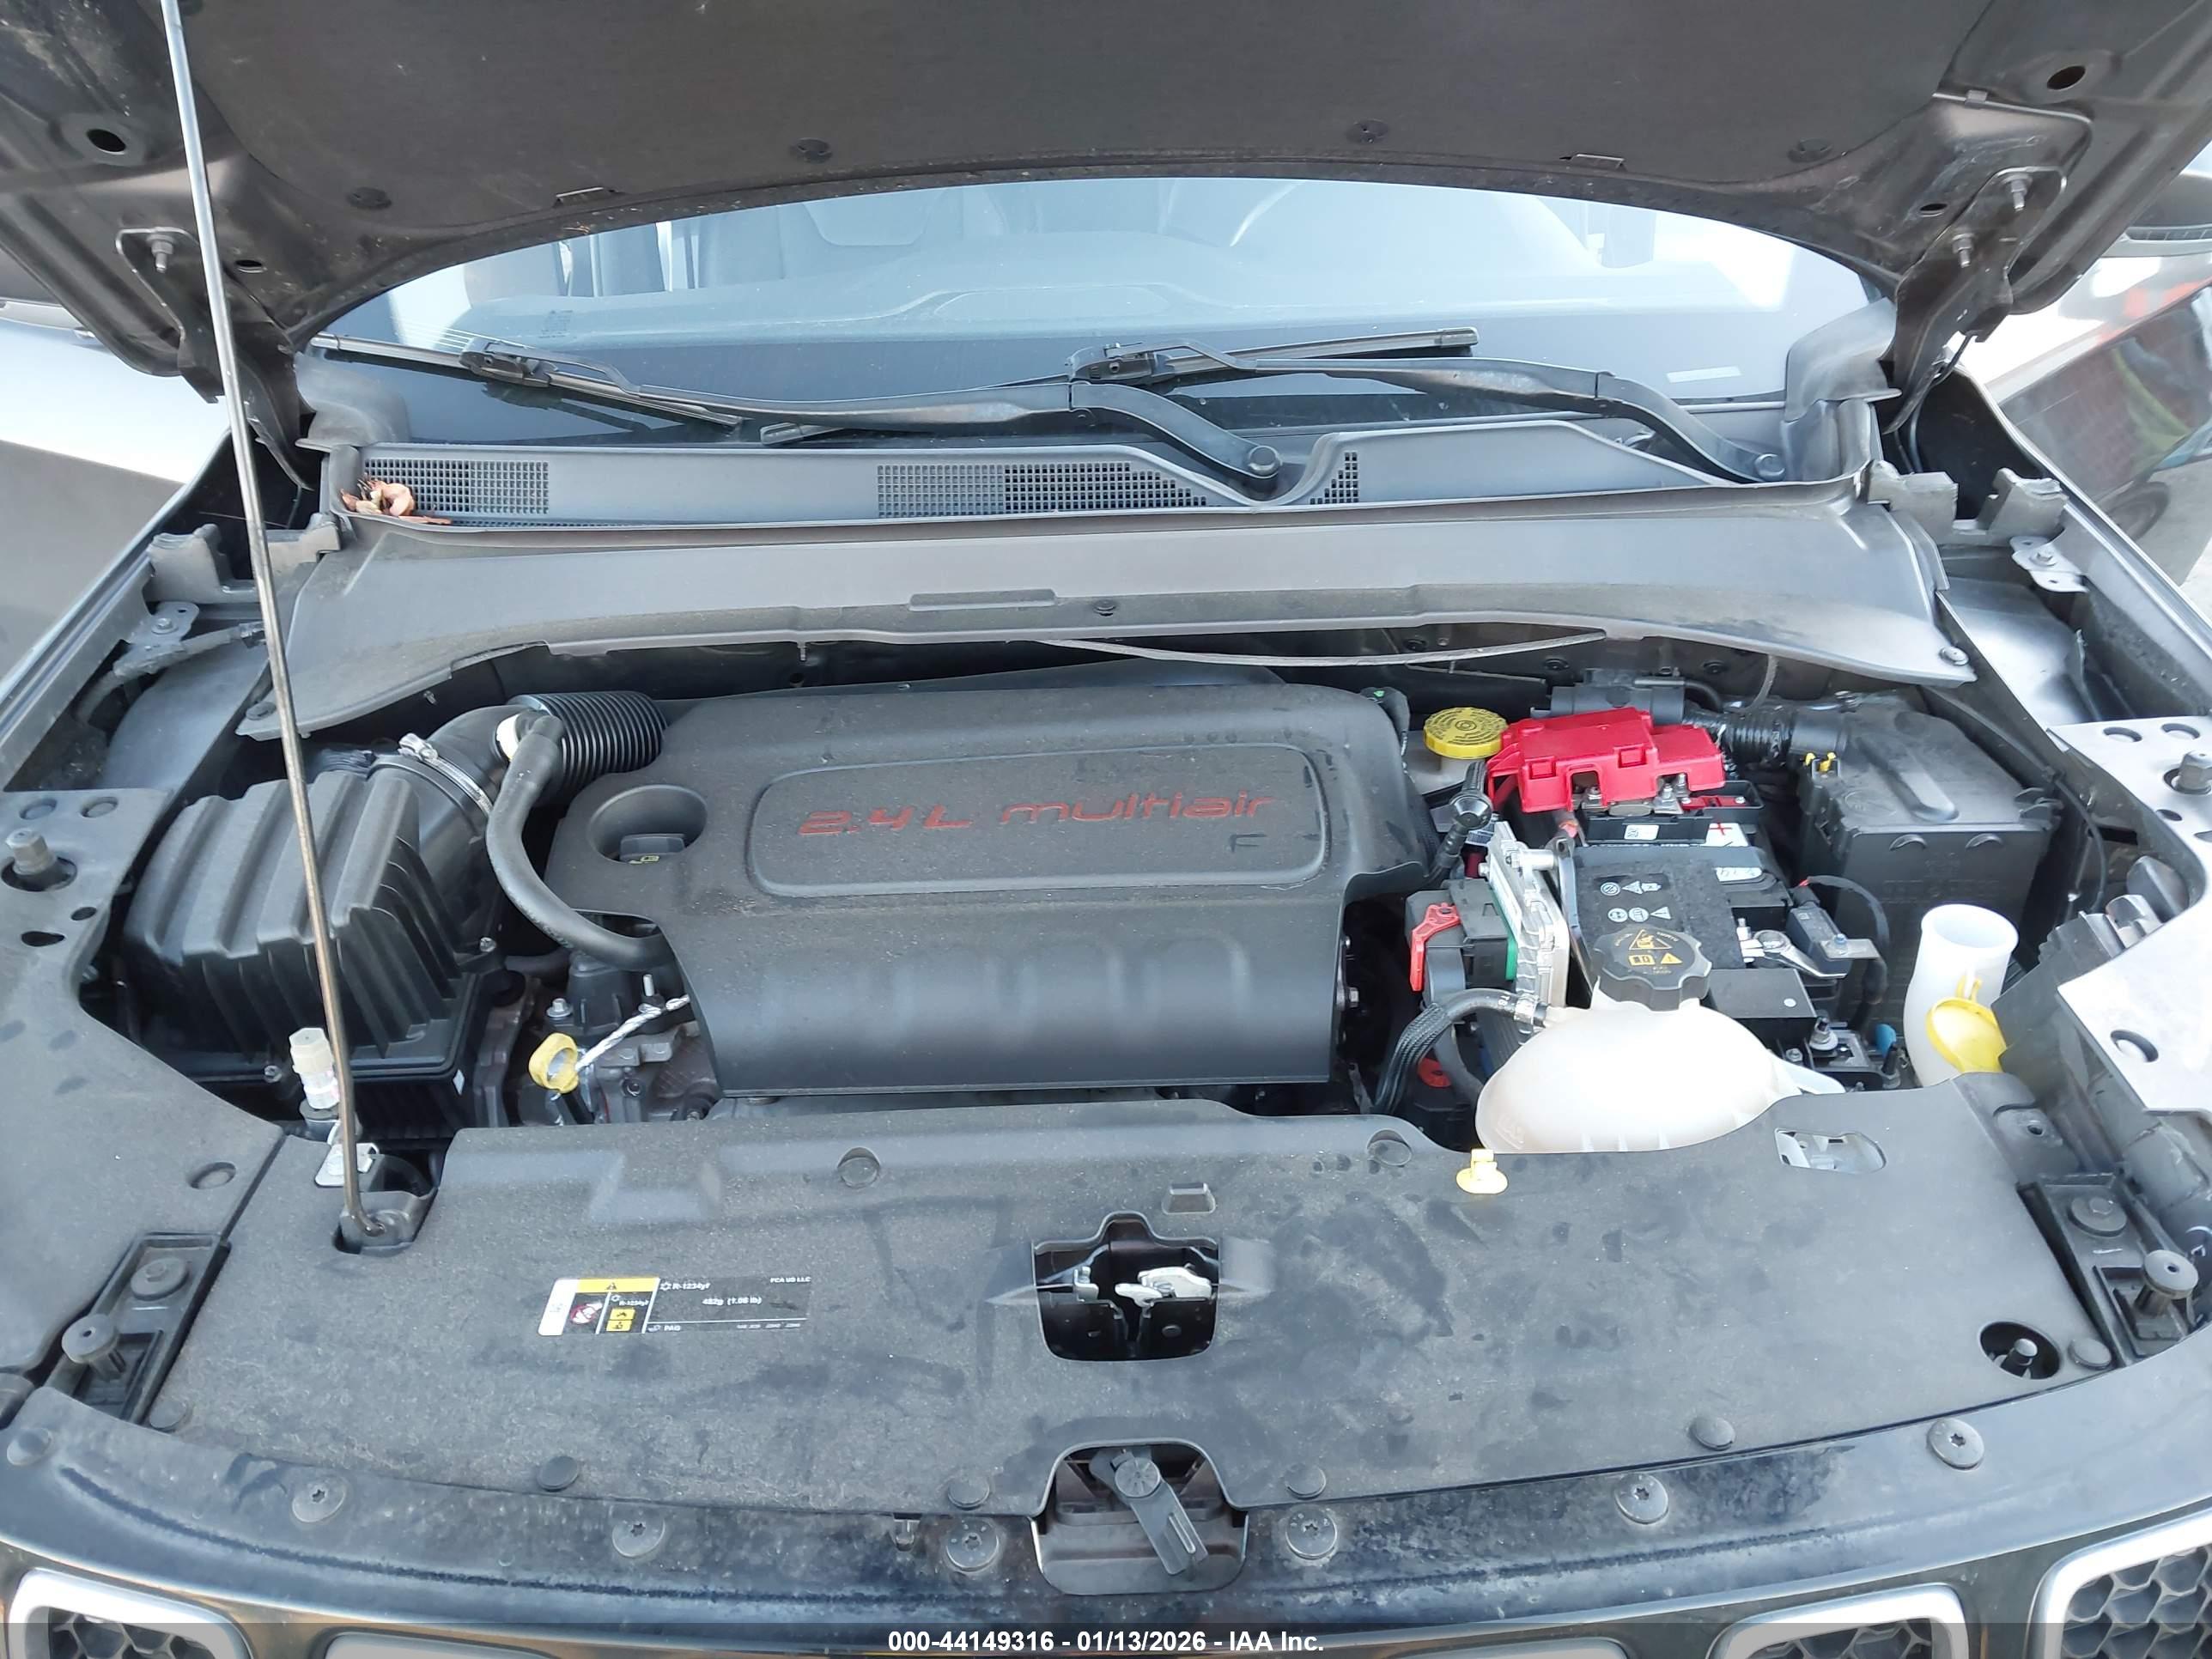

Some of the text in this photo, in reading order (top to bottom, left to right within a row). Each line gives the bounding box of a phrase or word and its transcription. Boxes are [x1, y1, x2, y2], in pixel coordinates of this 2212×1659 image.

[799, 789, 1274, 835] 2.4L multiair
[672, 1282, 711, 1291] R-1234yf
